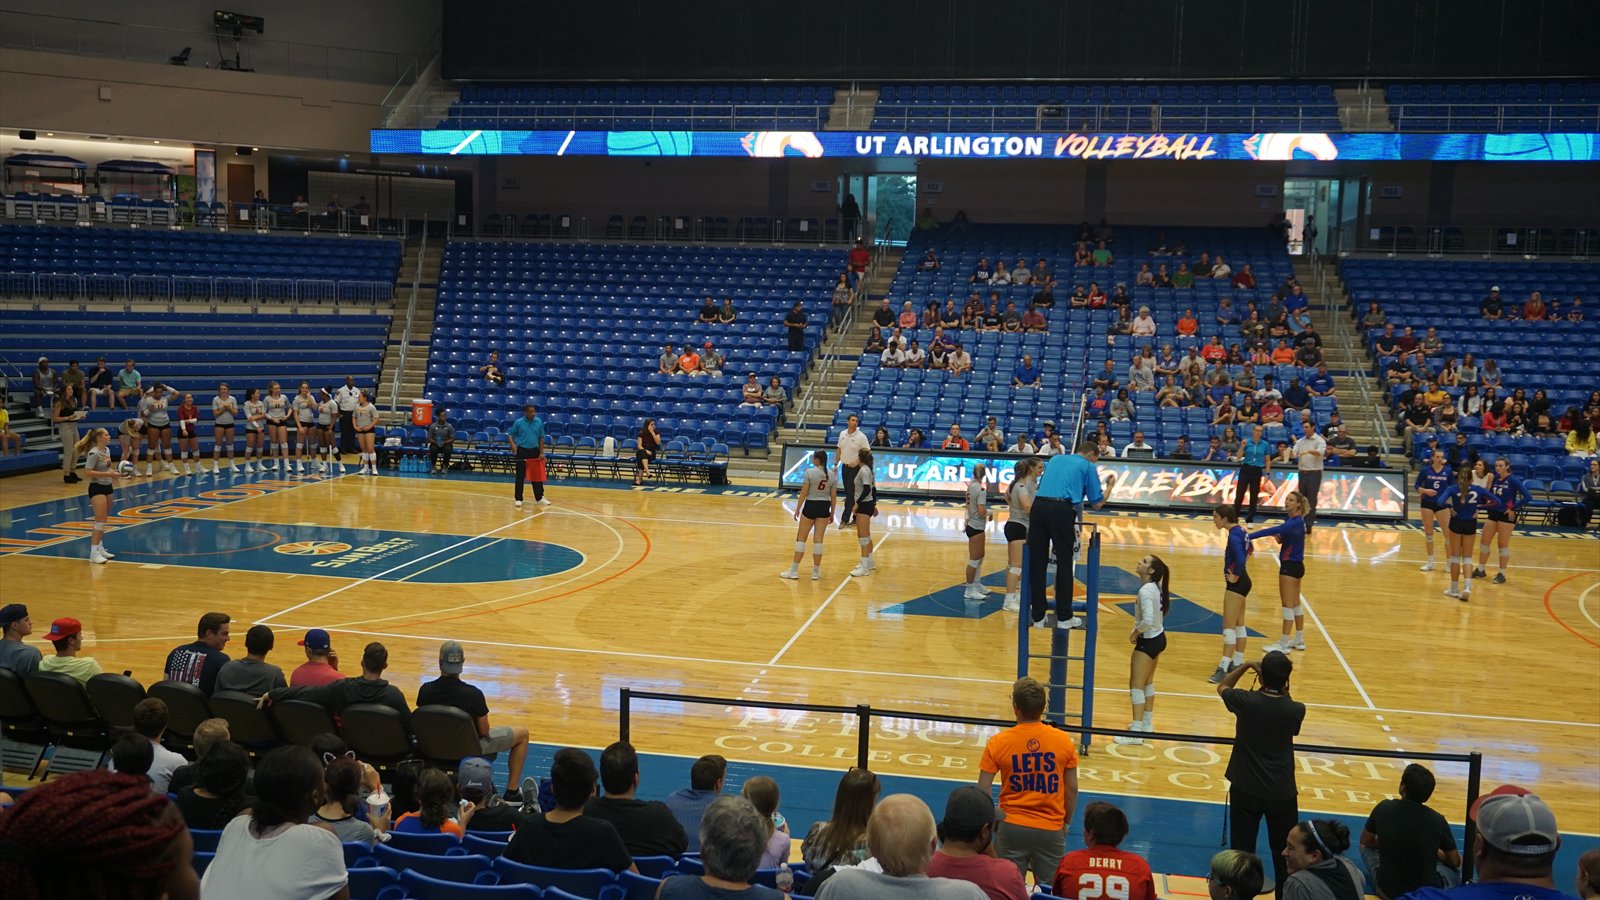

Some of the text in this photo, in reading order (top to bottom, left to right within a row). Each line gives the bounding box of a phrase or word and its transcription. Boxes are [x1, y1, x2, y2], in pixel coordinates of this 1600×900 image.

[855, 133, 1217, 159] UT ARLINGTON VOLLEYBALL
[888, 463, 918, 479] UT
[631, 485, 707, 494] THE
[817, 479, 827, 491] 6
[1433, 481, 1440, 489] 6
[1492, 486, 1503, 496] 14
[714, 735, 968, 770] COLLEGE
[1105, 743, 1396, 781] CORT
[1011, 752, 1056, 774] LETS
[1009, 773, 1059, 795] SHAG
[1089, 857, 1123, 870] BERRY
[1078, 873, 1130, 900] 29
